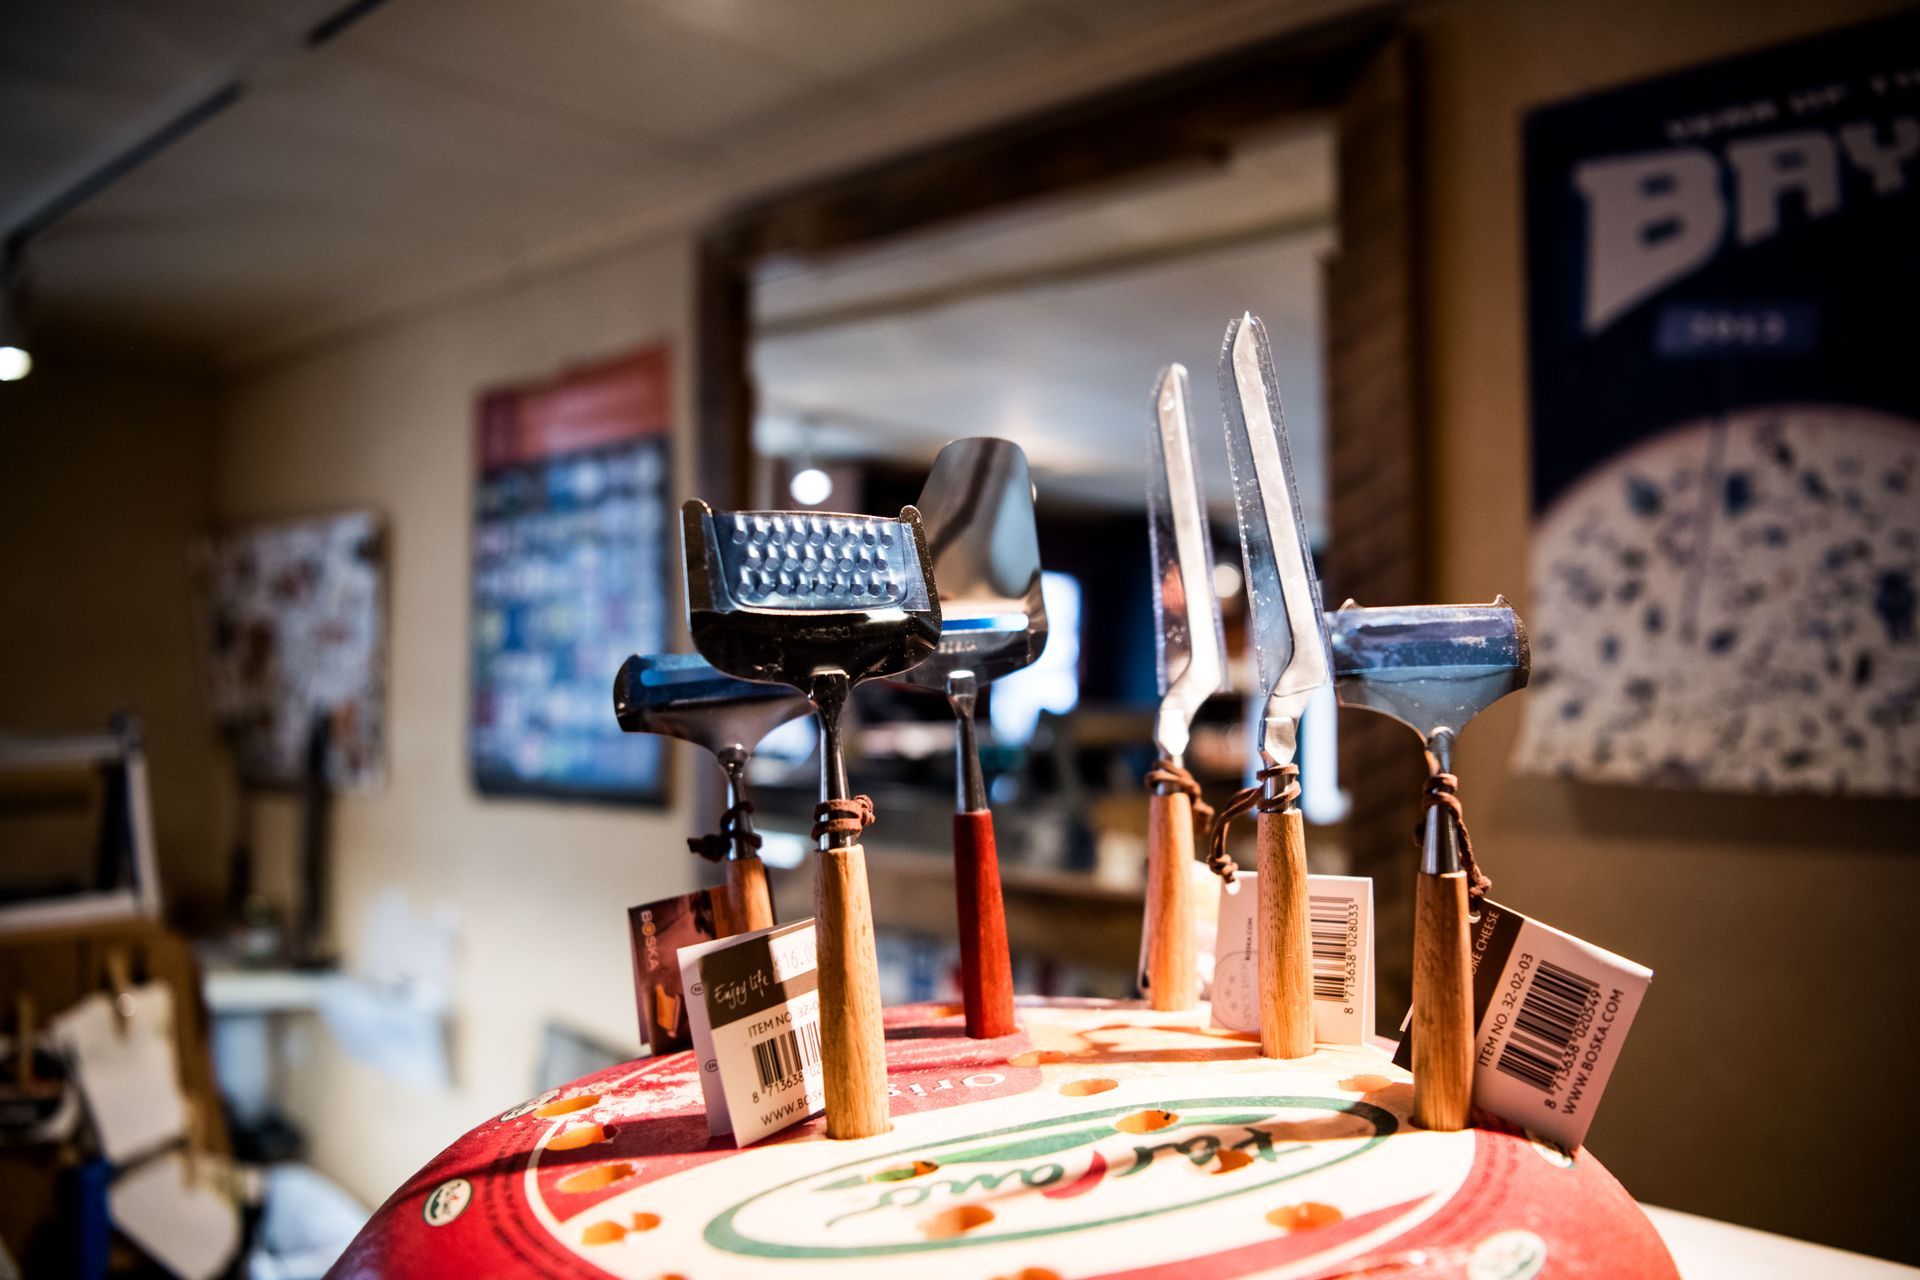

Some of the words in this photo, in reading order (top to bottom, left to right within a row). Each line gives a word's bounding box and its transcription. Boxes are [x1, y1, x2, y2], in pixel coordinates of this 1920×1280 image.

[640, 909, 661, 972] BOSKA
[1245, 917, 1253, 960] BOSKA.COM
[1347, 904, 1359, 947] 028033
[1475, 910, 1500, 951] CHEESE
[713, 980, 748, 1010] Enjoy
[749, 969, 769, 998] life
[1344, 954, 1357, 998] 713638
[748, 1018, 774, 1038] ITEM
[1343, 1007, 1354, 1015] 8
[1478, 1038, 1499, 1067] ITEM
[1492, 1013, 1509, 1036] NO.
[1502, 952, 1534, 1010] 32-02-03
[1544, 1099, 1556, 1110] 8
[1551, 1043, 1581, 1093] 713638
[1574, 989, 1602, 1039] 020549
[1562, 988, 1625, 1116] WWW.BOSKA.COM
[752, 1091, 759, 1103] 8
[767, 1071, 804, 1097] 713638
